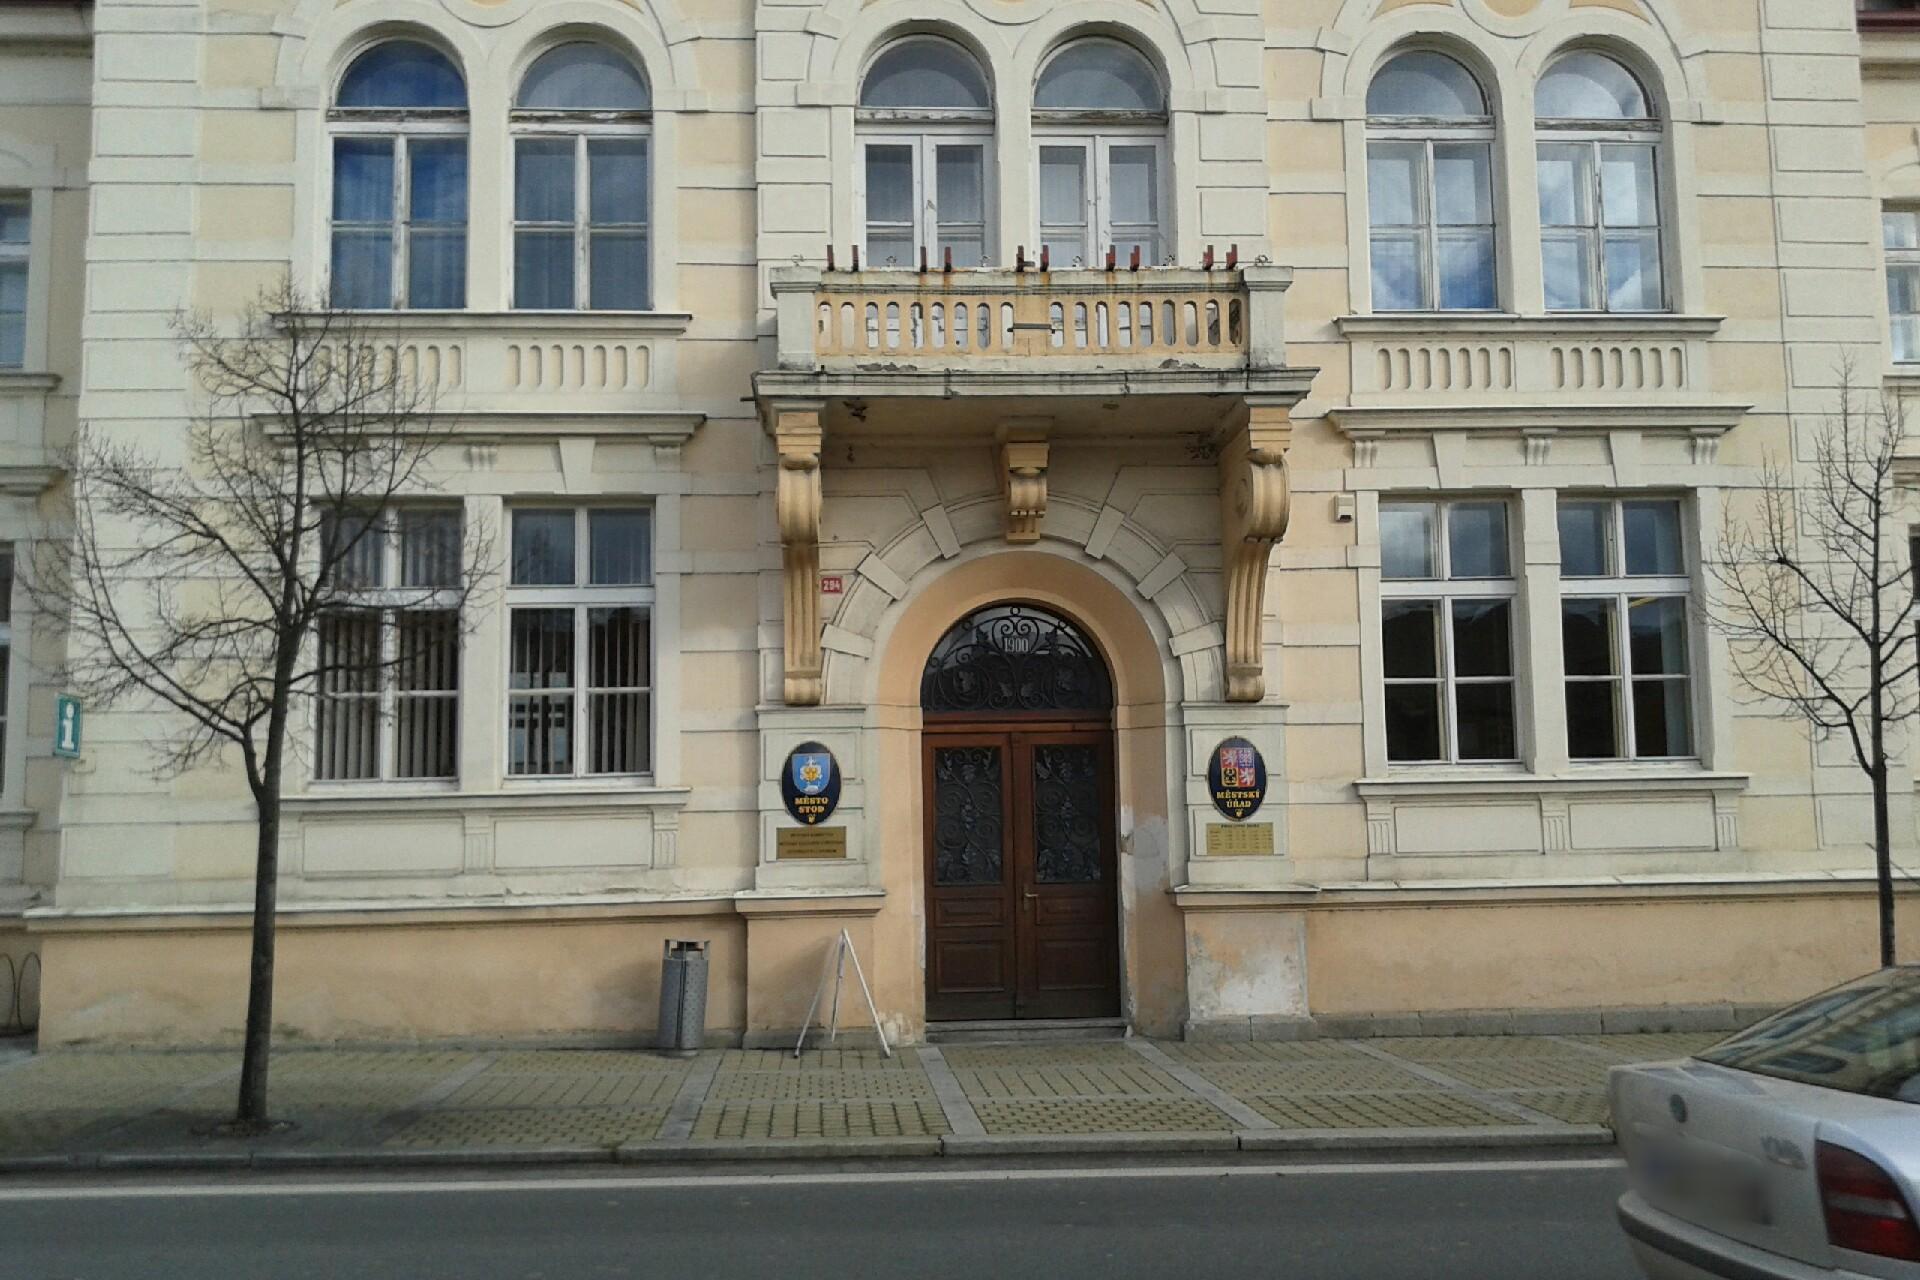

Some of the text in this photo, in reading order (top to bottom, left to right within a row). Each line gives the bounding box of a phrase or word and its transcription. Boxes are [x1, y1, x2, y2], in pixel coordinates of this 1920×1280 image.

[1004, 637, 1029, 652] 1900
[61, 702, 75, 750] i
[794, 796, 829, 805] MĚSTO
[798, 805, 825, 814] STOD
